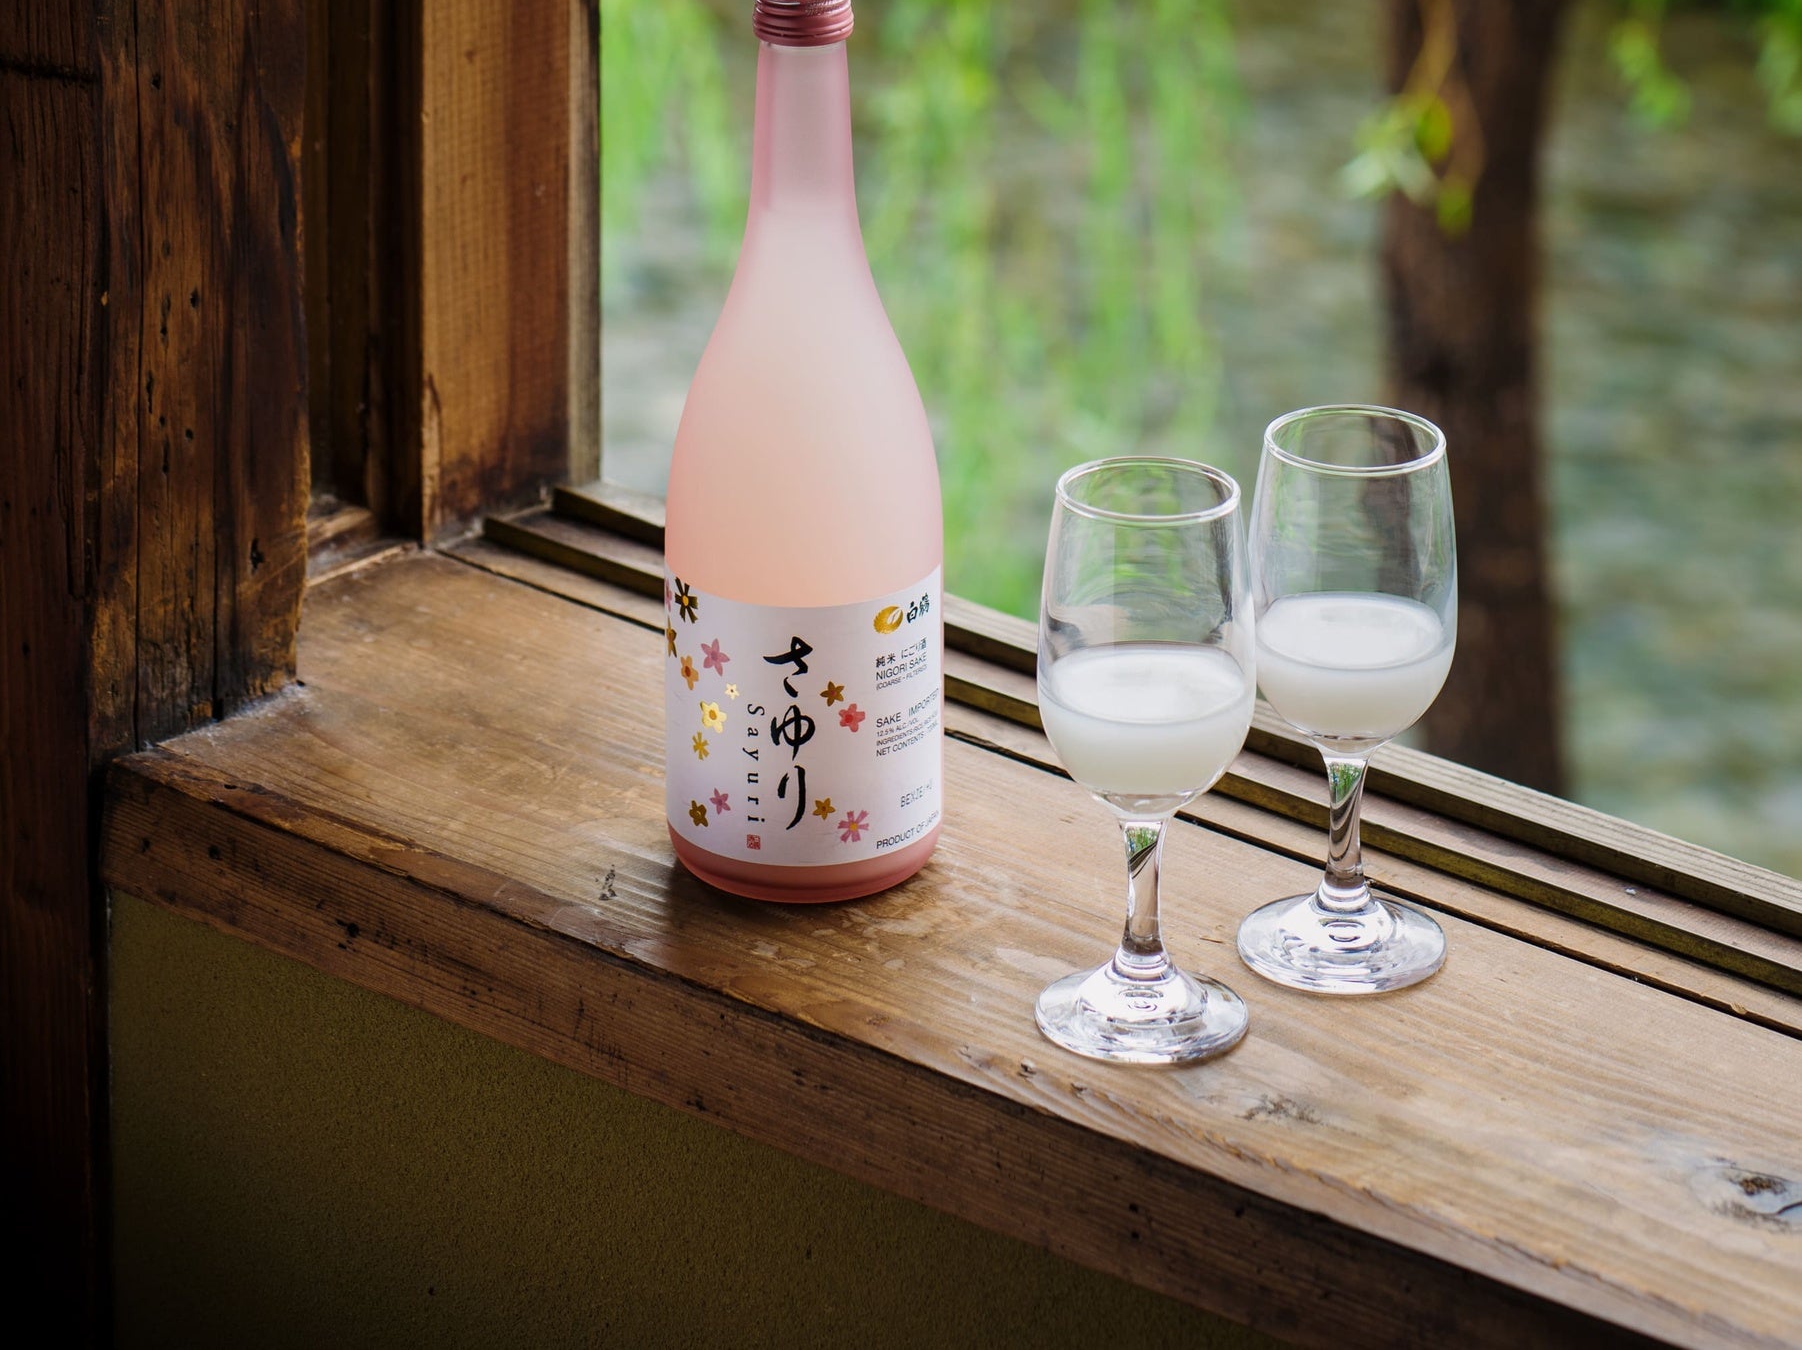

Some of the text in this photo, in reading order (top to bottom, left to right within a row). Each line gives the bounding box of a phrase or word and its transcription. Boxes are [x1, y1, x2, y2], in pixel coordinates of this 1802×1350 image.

[876, 651, 927, 681] NIGORI SAKE
[763, 636, 815, 830] さゆり
[876, 712, 901, 728] SAKE
[876, 731, 925, 757] NET CONTENTS
[742, 704, 765, 822] Sayuri
[876, 827, 915, 849] PRODUCT
